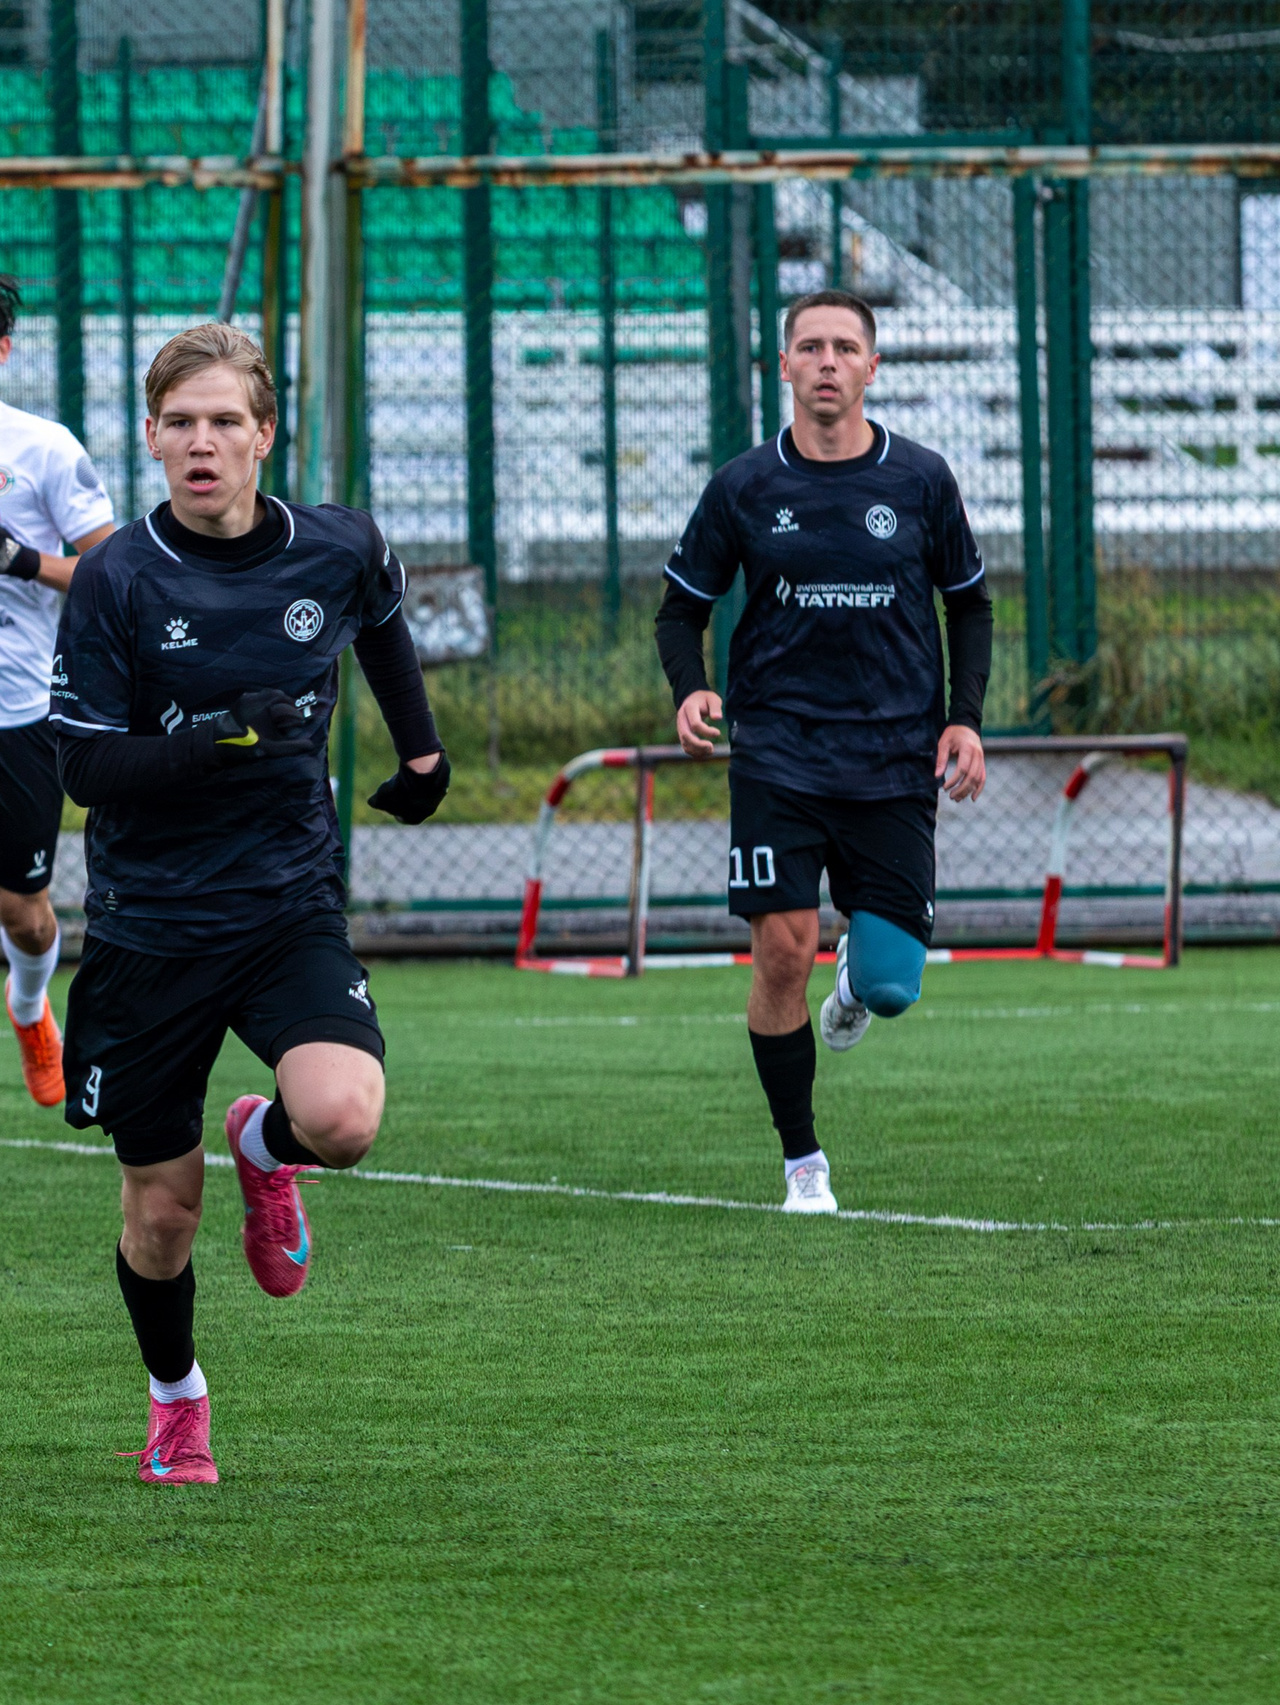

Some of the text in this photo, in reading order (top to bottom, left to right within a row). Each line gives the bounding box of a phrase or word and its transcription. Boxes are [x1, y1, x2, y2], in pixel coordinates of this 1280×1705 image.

[795, 593, 895, 608] TATNEFT
[161, 638, 198, 650] KELME
[730, 846, 776, 888] 10
